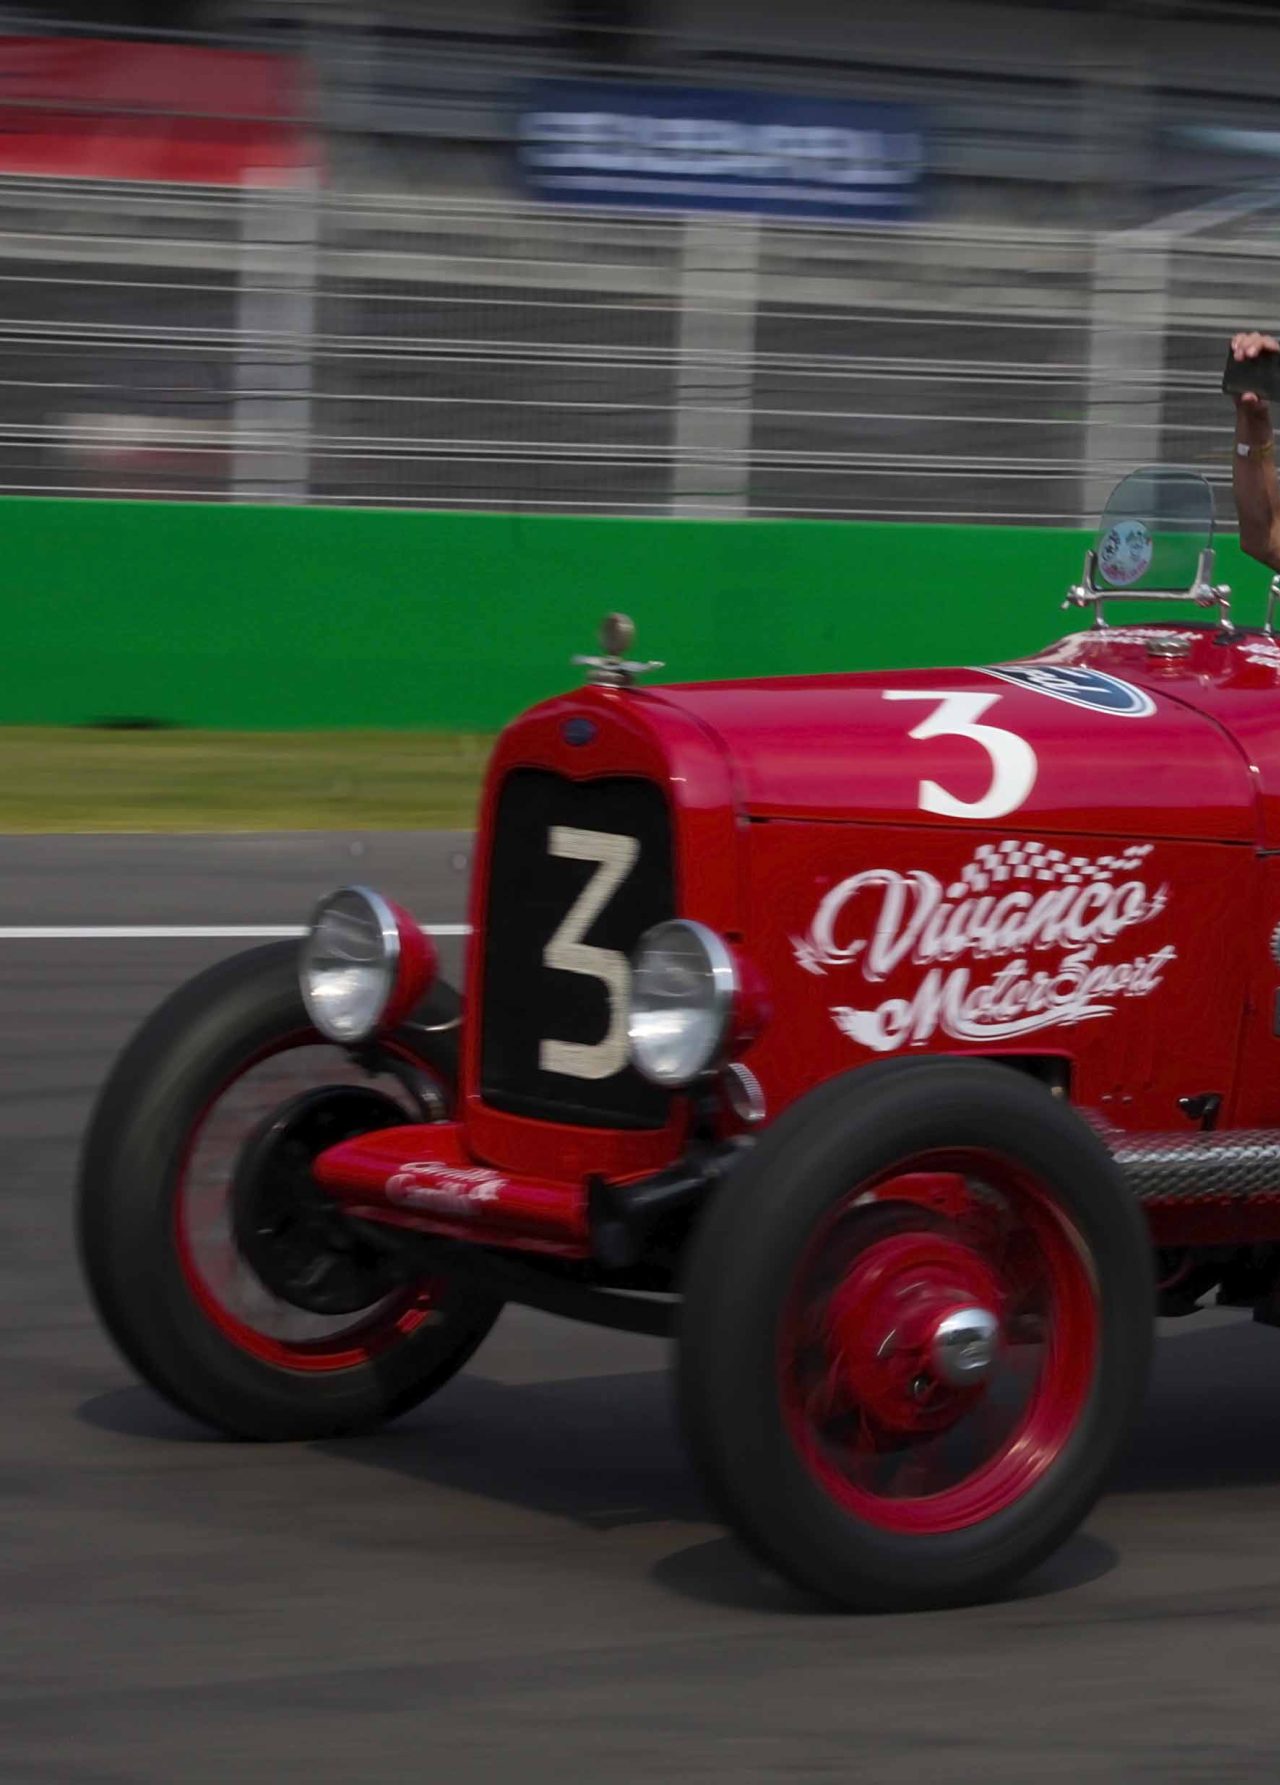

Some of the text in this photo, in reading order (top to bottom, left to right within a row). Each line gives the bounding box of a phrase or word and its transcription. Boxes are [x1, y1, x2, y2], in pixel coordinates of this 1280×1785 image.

[881, 690, 1038, 819] 3
[538, 826, 640, 1079] 3
[790, 869, 1170, 982] Vivanco
